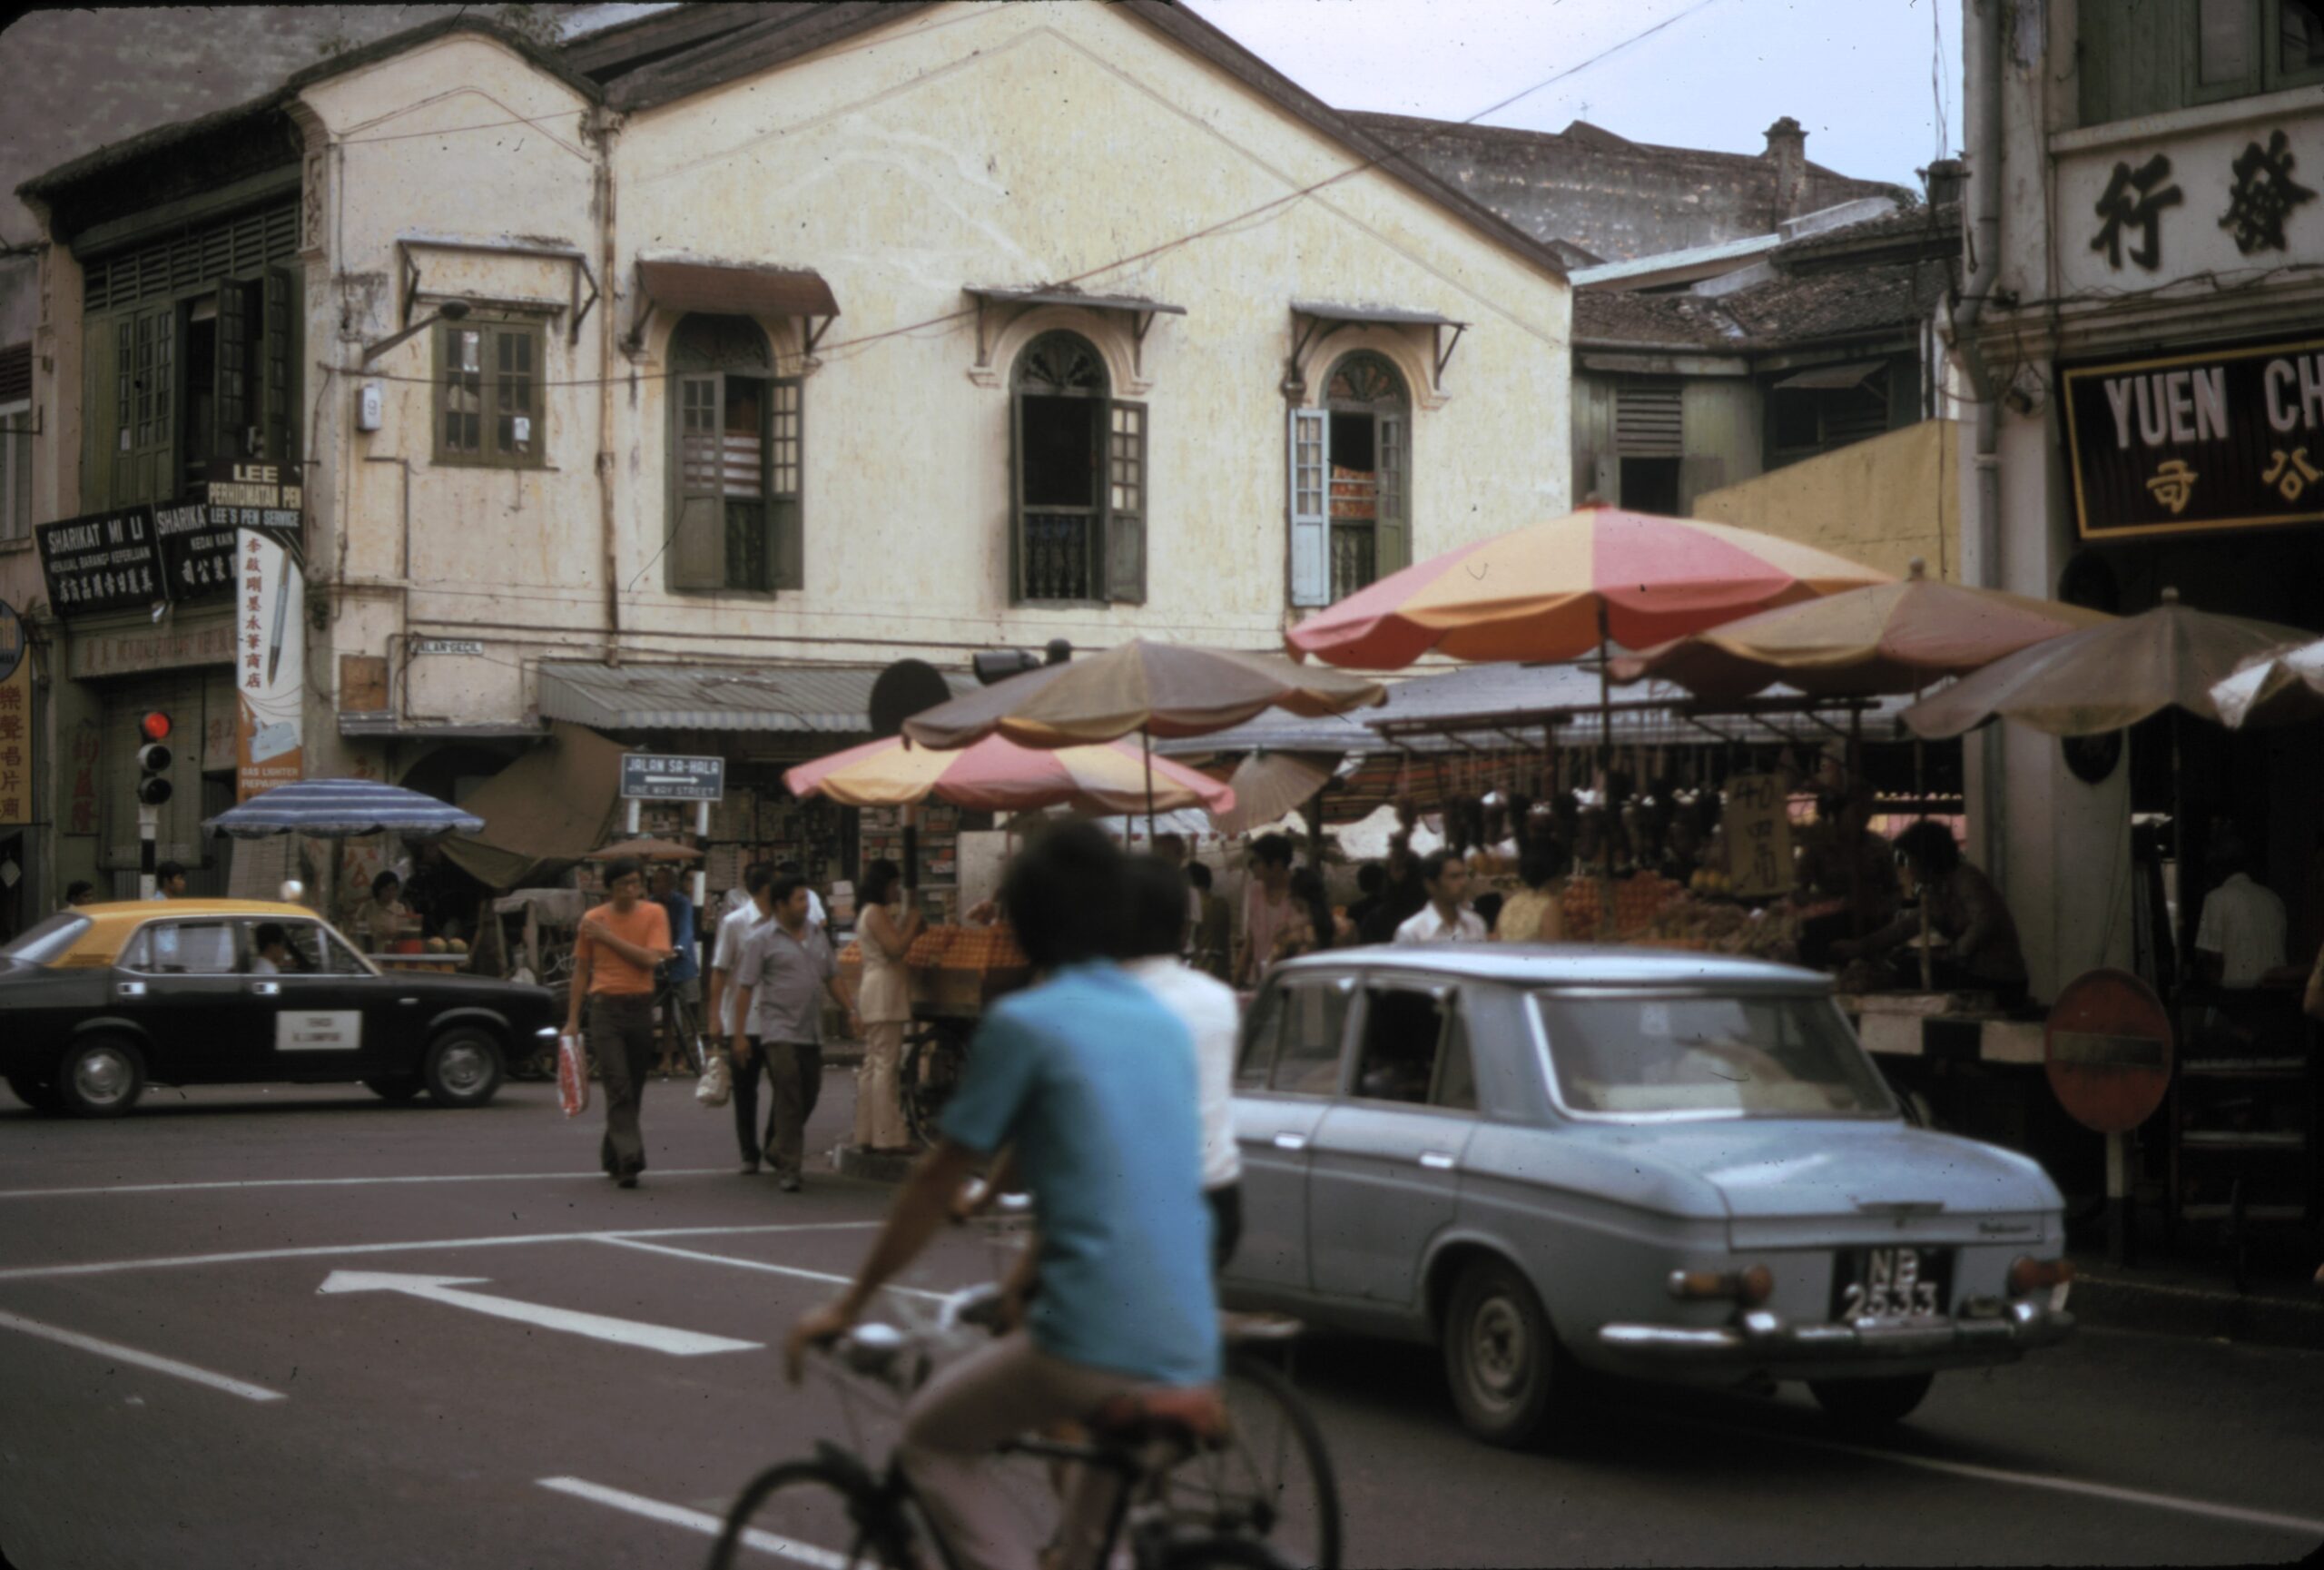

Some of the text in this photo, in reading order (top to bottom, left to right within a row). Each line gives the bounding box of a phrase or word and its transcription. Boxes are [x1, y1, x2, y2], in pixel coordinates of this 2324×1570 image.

[2102, 366, 2230, 450] YUEN
[233, 463, 279, 483] LEE
[208, 481, 280, 508] PERHIDMATAN
[156, 503, 208, 536] SHARIKA
[210, 507, 300, 528] LEE'S PEN SERVICE
[47, 515, 144, 555] SHARIKAT MI LI
[190, 534, 214, 551] KEDAI
[241, 766, 299, 777] GAS LIGHTER
[627, 758, 665, 773] JALAN
[628, 785, 715, 796] ONE WAY STREET
[1733, 776, 1773, 809] 40
[1868, 1248, 1920, 1284] NB
[1843, 1280, 1938, 1319] 2533
